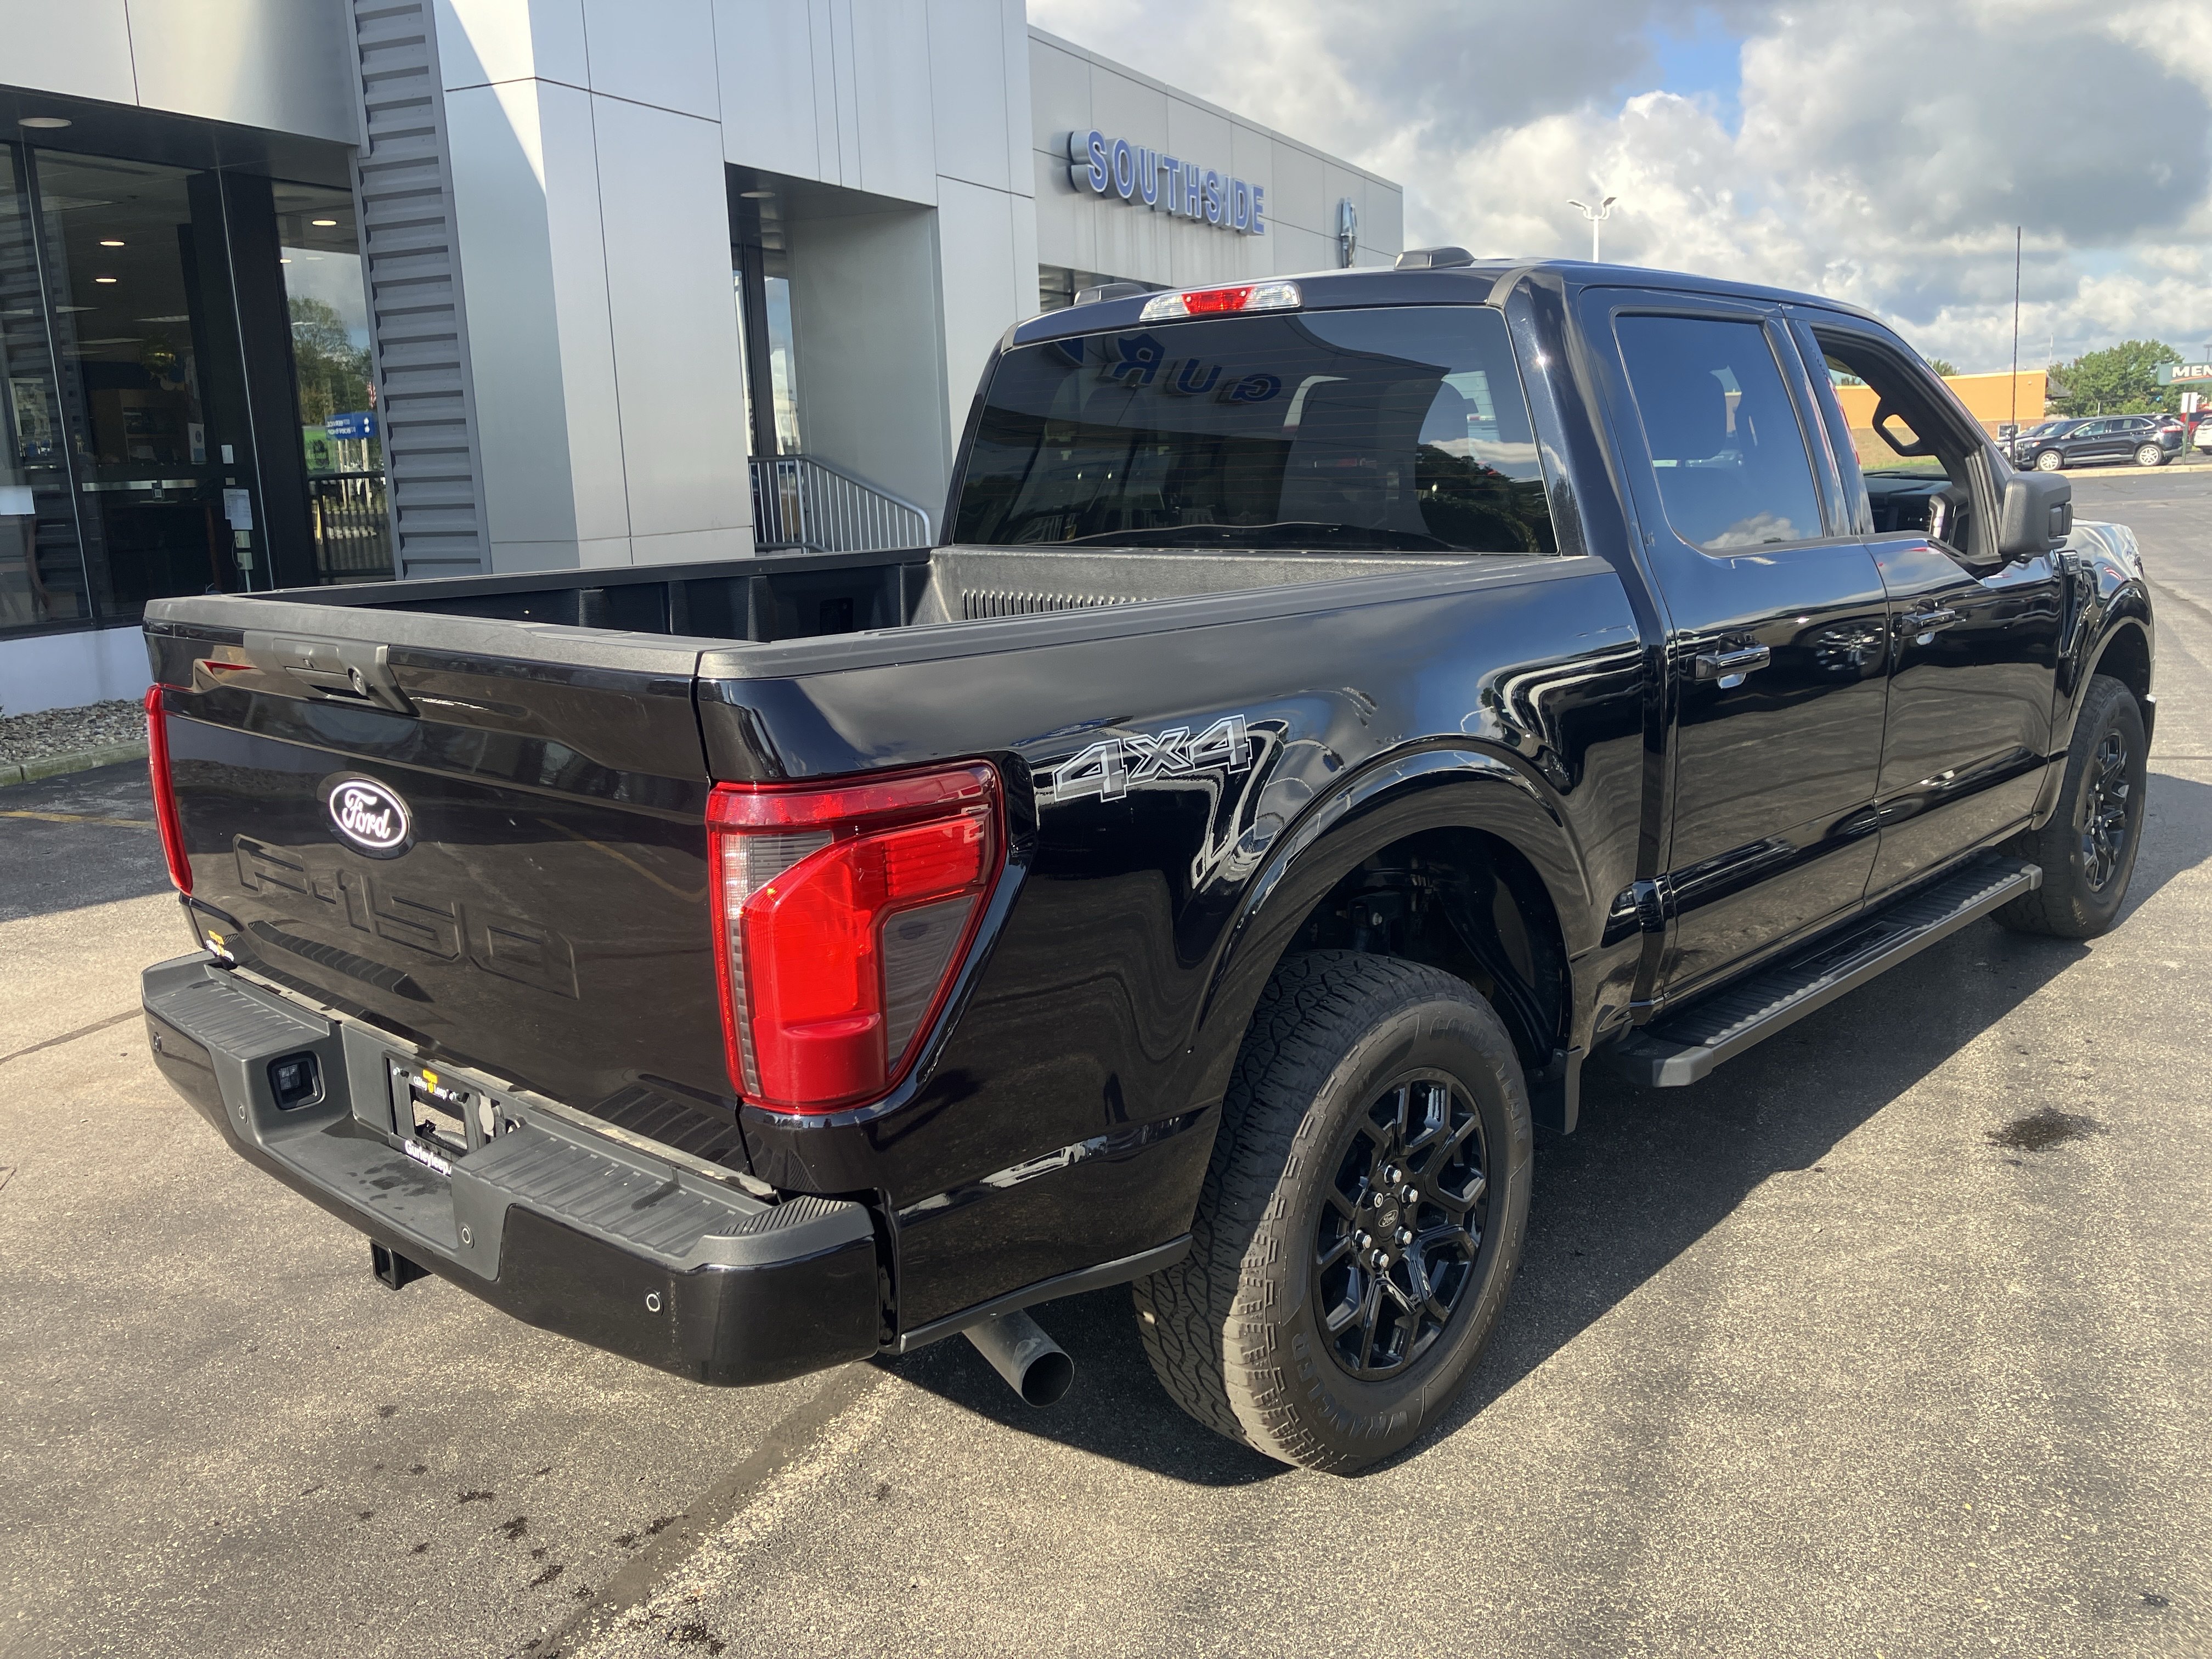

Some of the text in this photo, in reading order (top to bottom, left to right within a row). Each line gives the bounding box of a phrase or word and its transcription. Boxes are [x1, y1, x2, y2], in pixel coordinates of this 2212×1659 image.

[1085, 129, 1266, 236] SOUTHSIDE
[341, 788, 392, 839] Ford
[233, 833, 579, 1000] F-150
